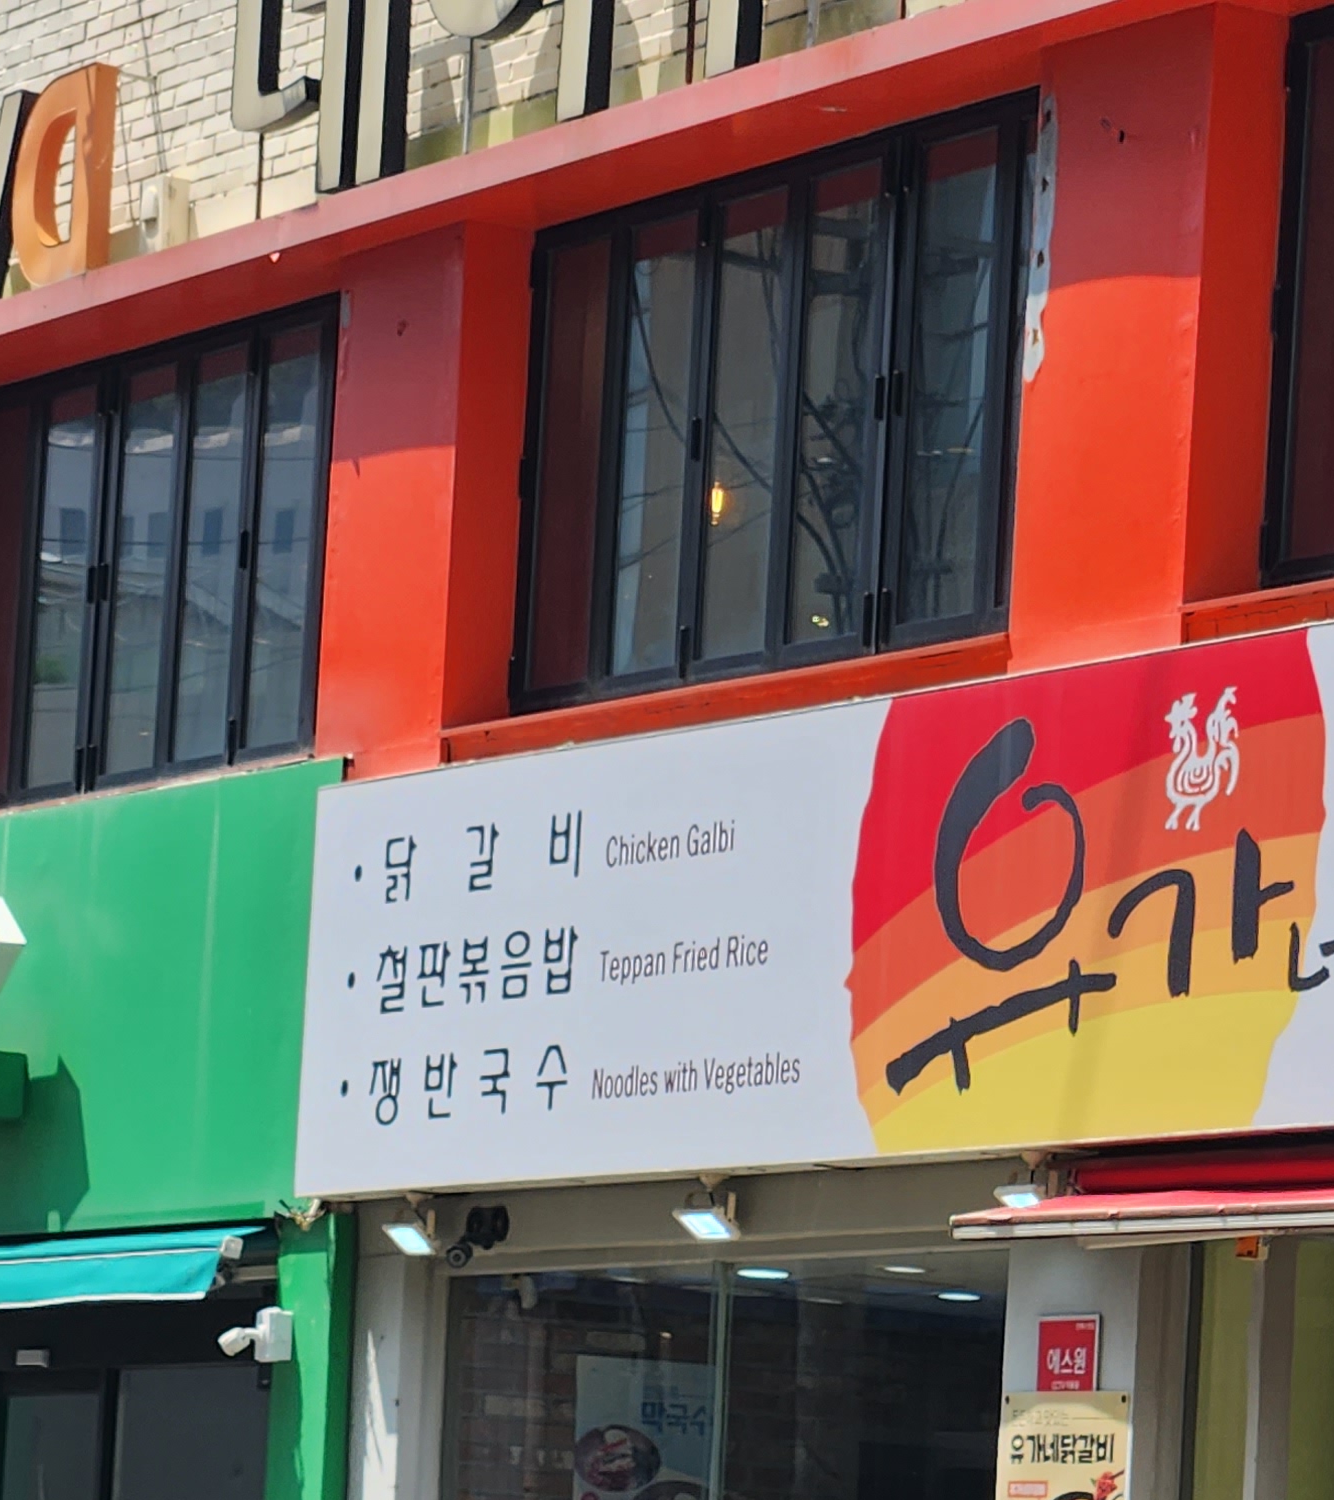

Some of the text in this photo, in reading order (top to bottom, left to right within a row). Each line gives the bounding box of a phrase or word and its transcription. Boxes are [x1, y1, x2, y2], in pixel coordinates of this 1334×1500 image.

[605, 830, 680, 869] Chicken
[686, 820, 735, 859] Galbi
[377, 925, 769, 1014] 철판볶음밥 Teppan Fried Rice
[592, 1065, 658, 1100] Noodles
[664, 1061, 697, 1094] with
[704, 1052, 801, 1096] Vegetables
[1047, 1346, 1087, 1375] 에스원
